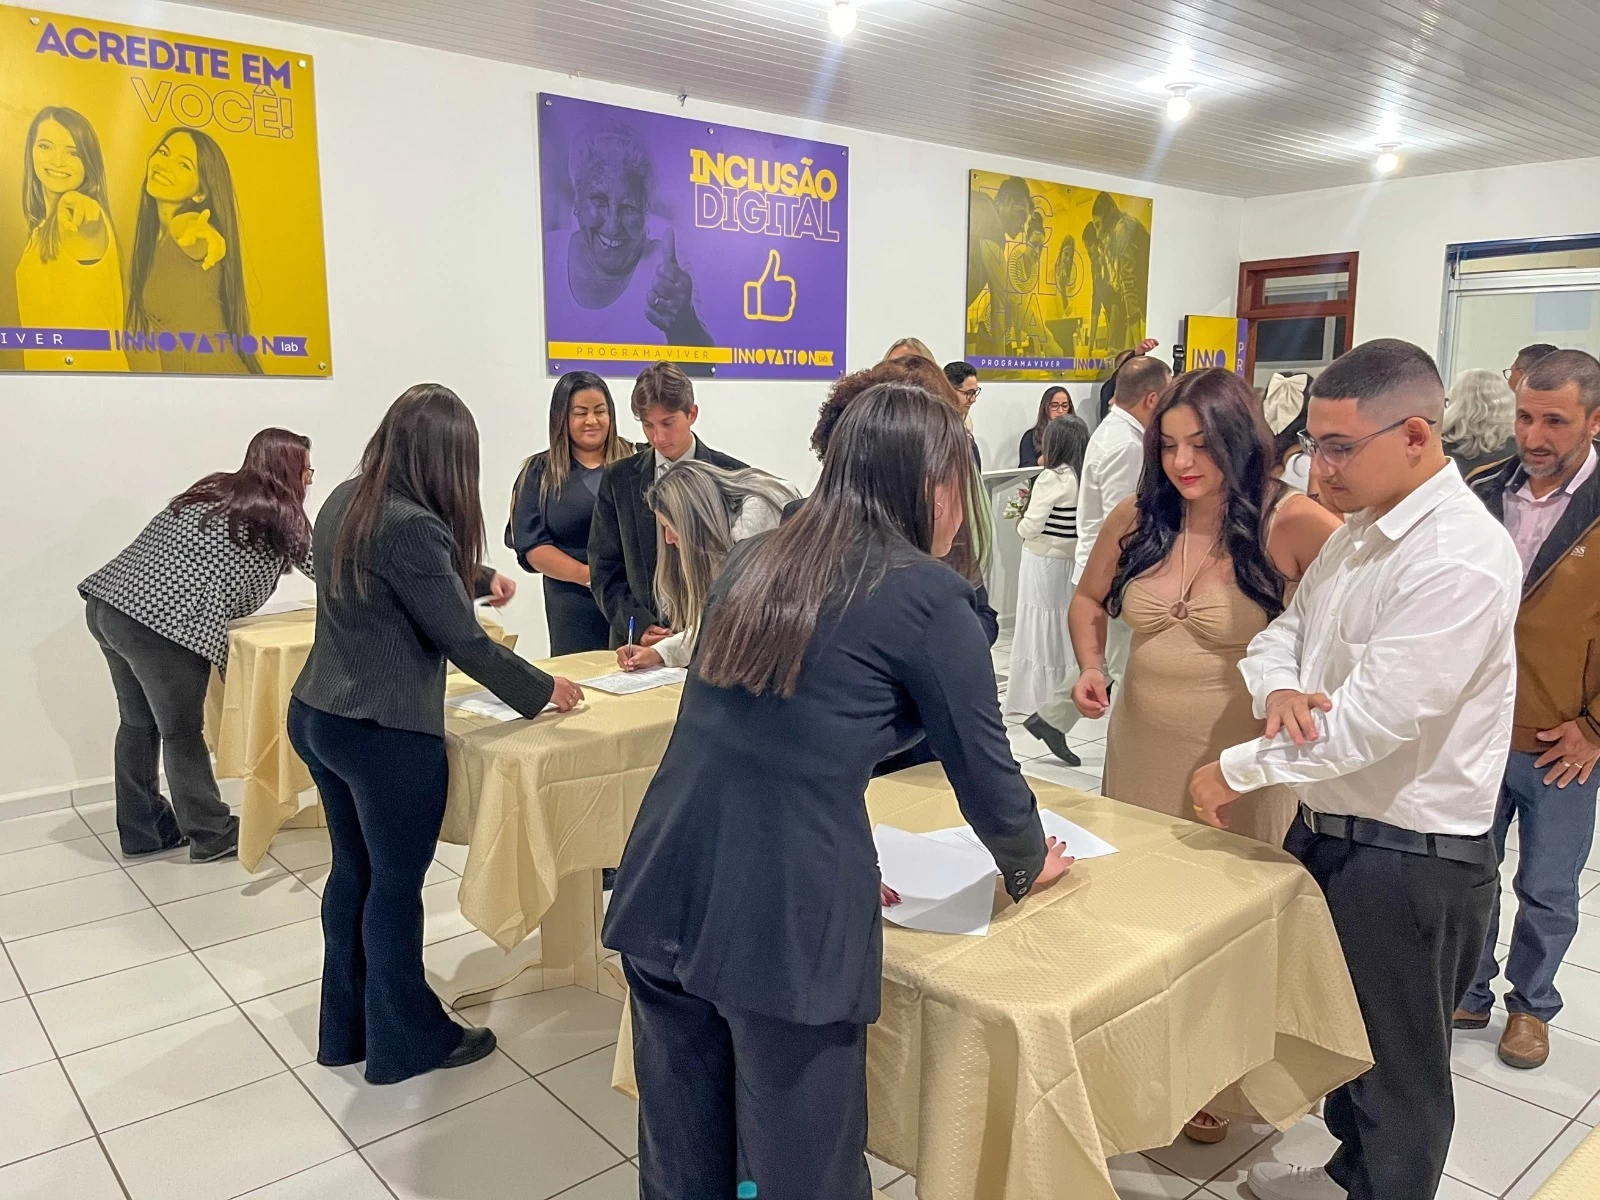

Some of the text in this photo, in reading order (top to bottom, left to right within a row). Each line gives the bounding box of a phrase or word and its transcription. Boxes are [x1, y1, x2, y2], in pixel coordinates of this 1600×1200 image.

[35, 23, 292, 90] ACREDITE EM
[130, 76, 294, 140] VOCÊ!
[689, 148, 838, 202] INCLUSÃO
[695, 182, 840, 242] DIGITAL
[0, 332, 63, 345] IVER
[114, 329, 299, 355] INNOVATION lab
[576, 346, 710, 359] PROGRAMA VIVER
[733, 347, 828, 366] INNOVATION lab
[981, 358, 1032, 367] PROGRAMA
